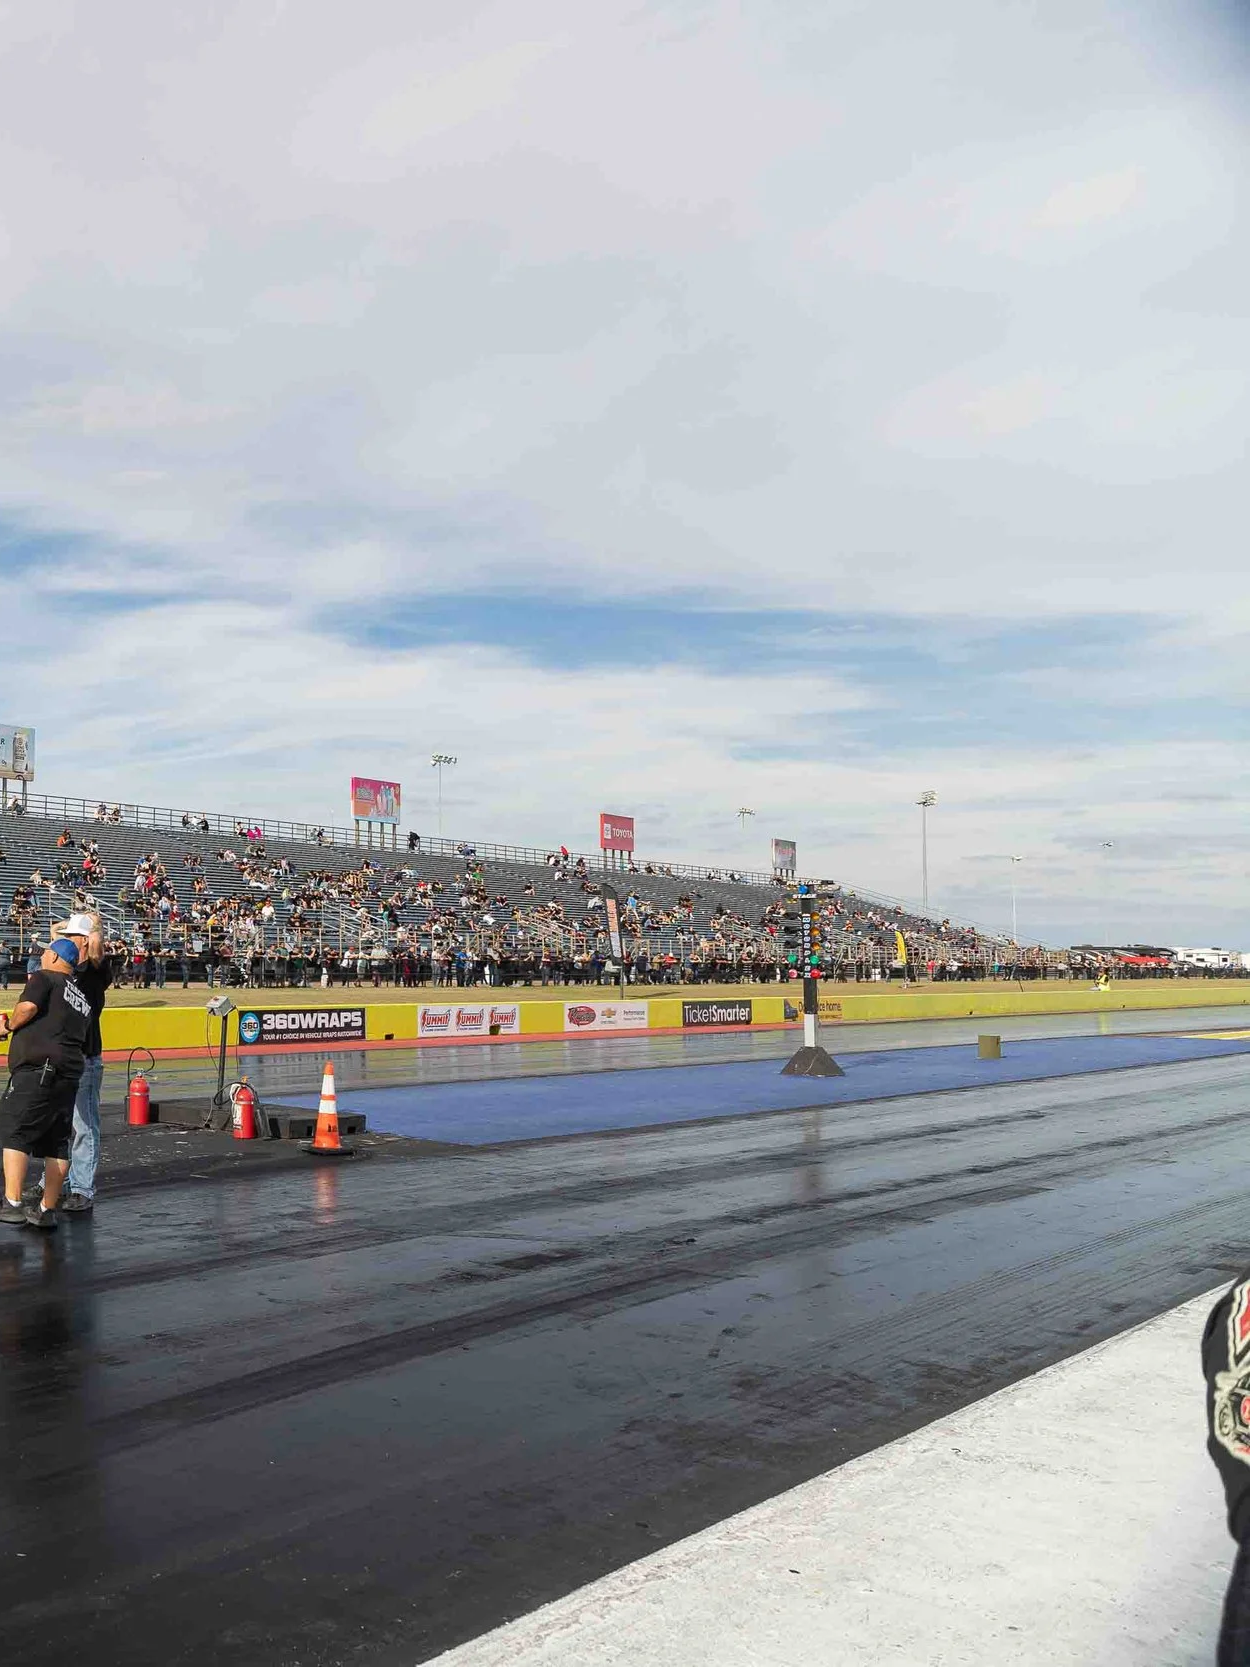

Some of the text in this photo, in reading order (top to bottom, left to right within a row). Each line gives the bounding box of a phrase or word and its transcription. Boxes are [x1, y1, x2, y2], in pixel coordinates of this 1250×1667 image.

[612, 827, 633, 839] TOYOTA
[63, 986, 92, 1017] CREW
[262, 1010, 363, 1030] 360WRAPS
[683, 1003, 750, 1023] TicketSmarter
[241, 1021, 259, 1030] 360
